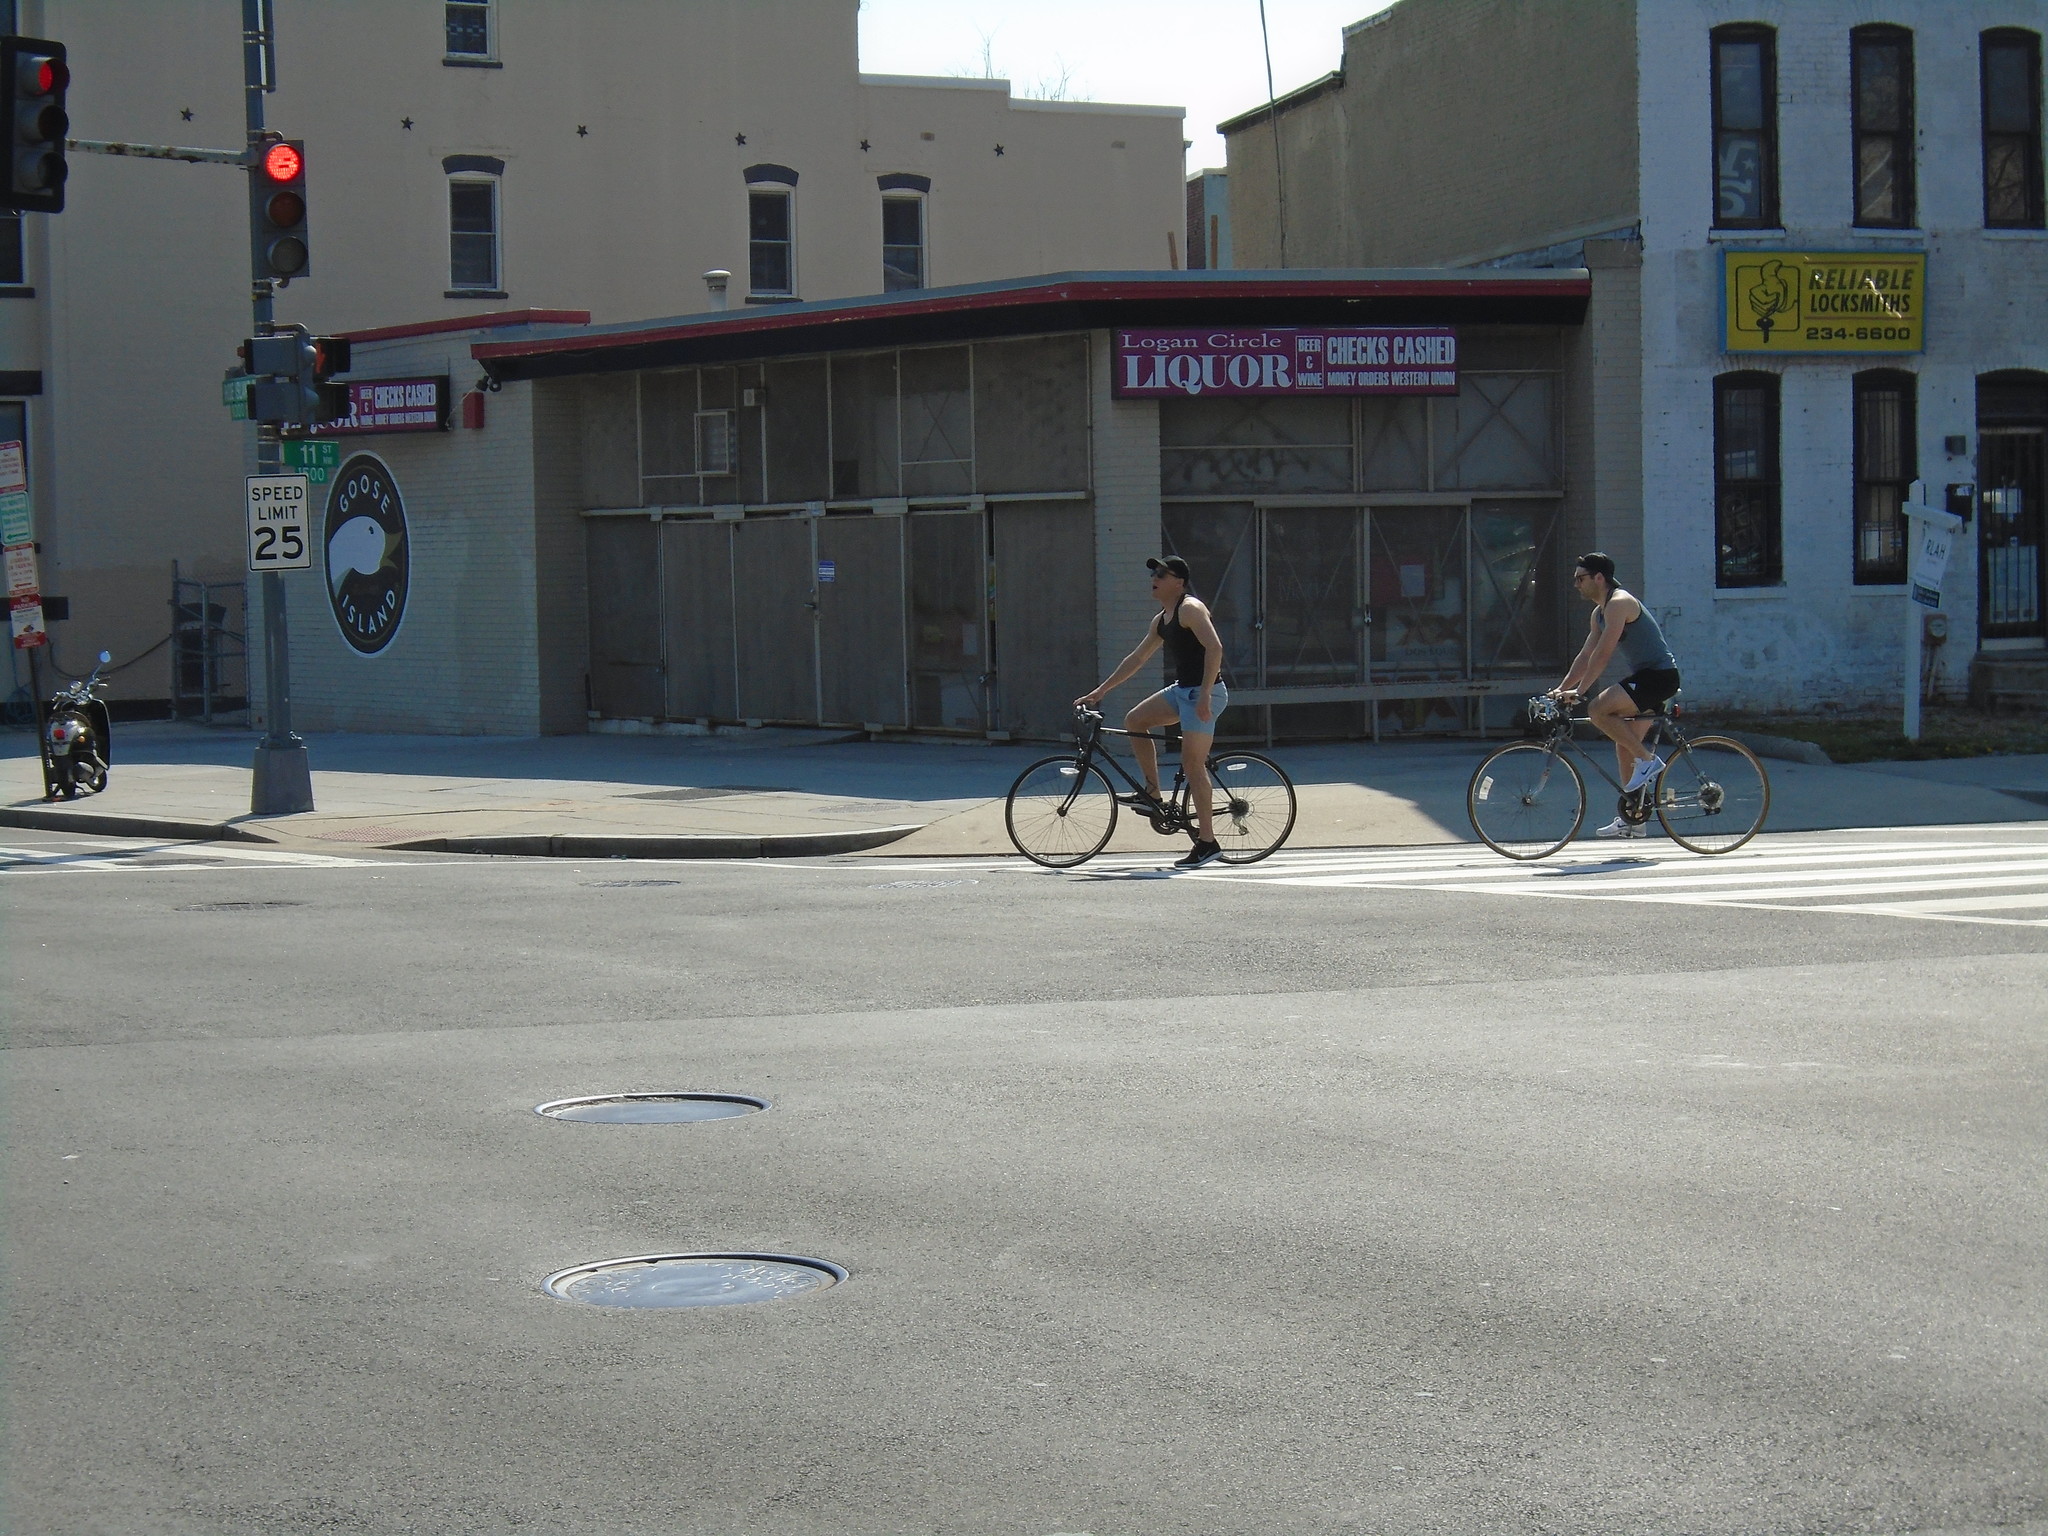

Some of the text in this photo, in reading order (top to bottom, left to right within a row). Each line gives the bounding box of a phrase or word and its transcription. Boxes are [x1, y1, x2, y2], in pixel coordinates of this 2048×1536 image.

[1809, 268, 1915, 290] RELIABLE
[1810, 293, 1911, 313] LOCKSMITHS
[1122, 333, 1282, 351] Logan Circle
[1806, 327, 1911, 340] 234-6600
[1298, 338, 1321, 352] BEER
[1327, 336, 1456, 365] CHECKS CASHED
[1306, 355, 1314, 369] &
[1122, 354, 1294, 395] LIQUOR
[1298, 372, 1322, 386] WINE
[1327, 371, 1456, 386] MONEY ORDERS WESTERN UNION
[374, 383, 437, 409] CHECKS CASHED
[300, 444, 318, 465] 11
[322, 445, 332, 454] ST
[252, 486, 303, 502] SPEED
[340, 474, 392, 514] GOOSE
[258, 505, 298, 521] LIMIT
[254, 525, 304, 560] 25
[342, 589, 396, 634] ISLAND
